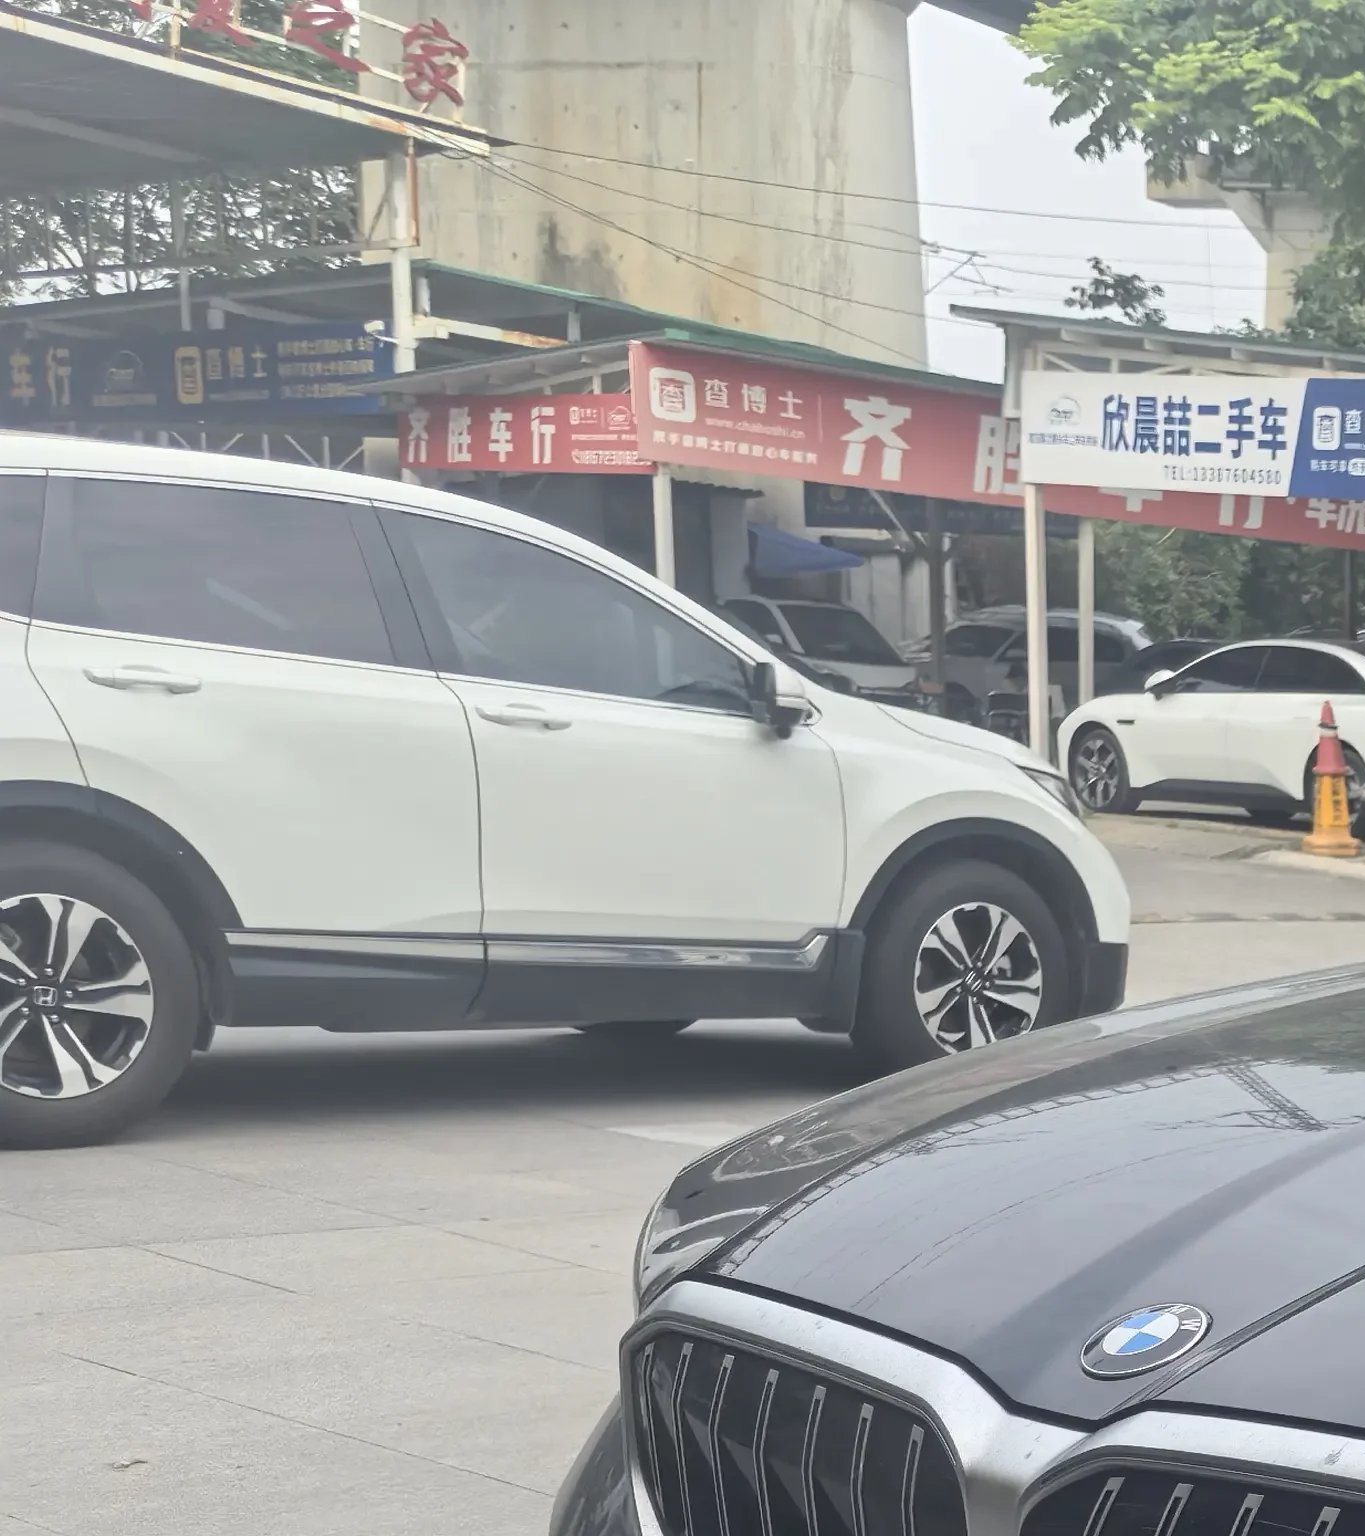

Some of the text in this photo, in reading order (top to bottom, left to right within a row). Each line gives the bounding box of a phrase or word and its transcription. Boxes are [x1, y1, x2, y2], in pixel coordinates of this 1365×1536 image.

[704, 378, 804, 420] 查博士
[1101, 393, 1288, 461] 欣晨喆二手车
[408, 406, 558, 465] 齐胜车行
